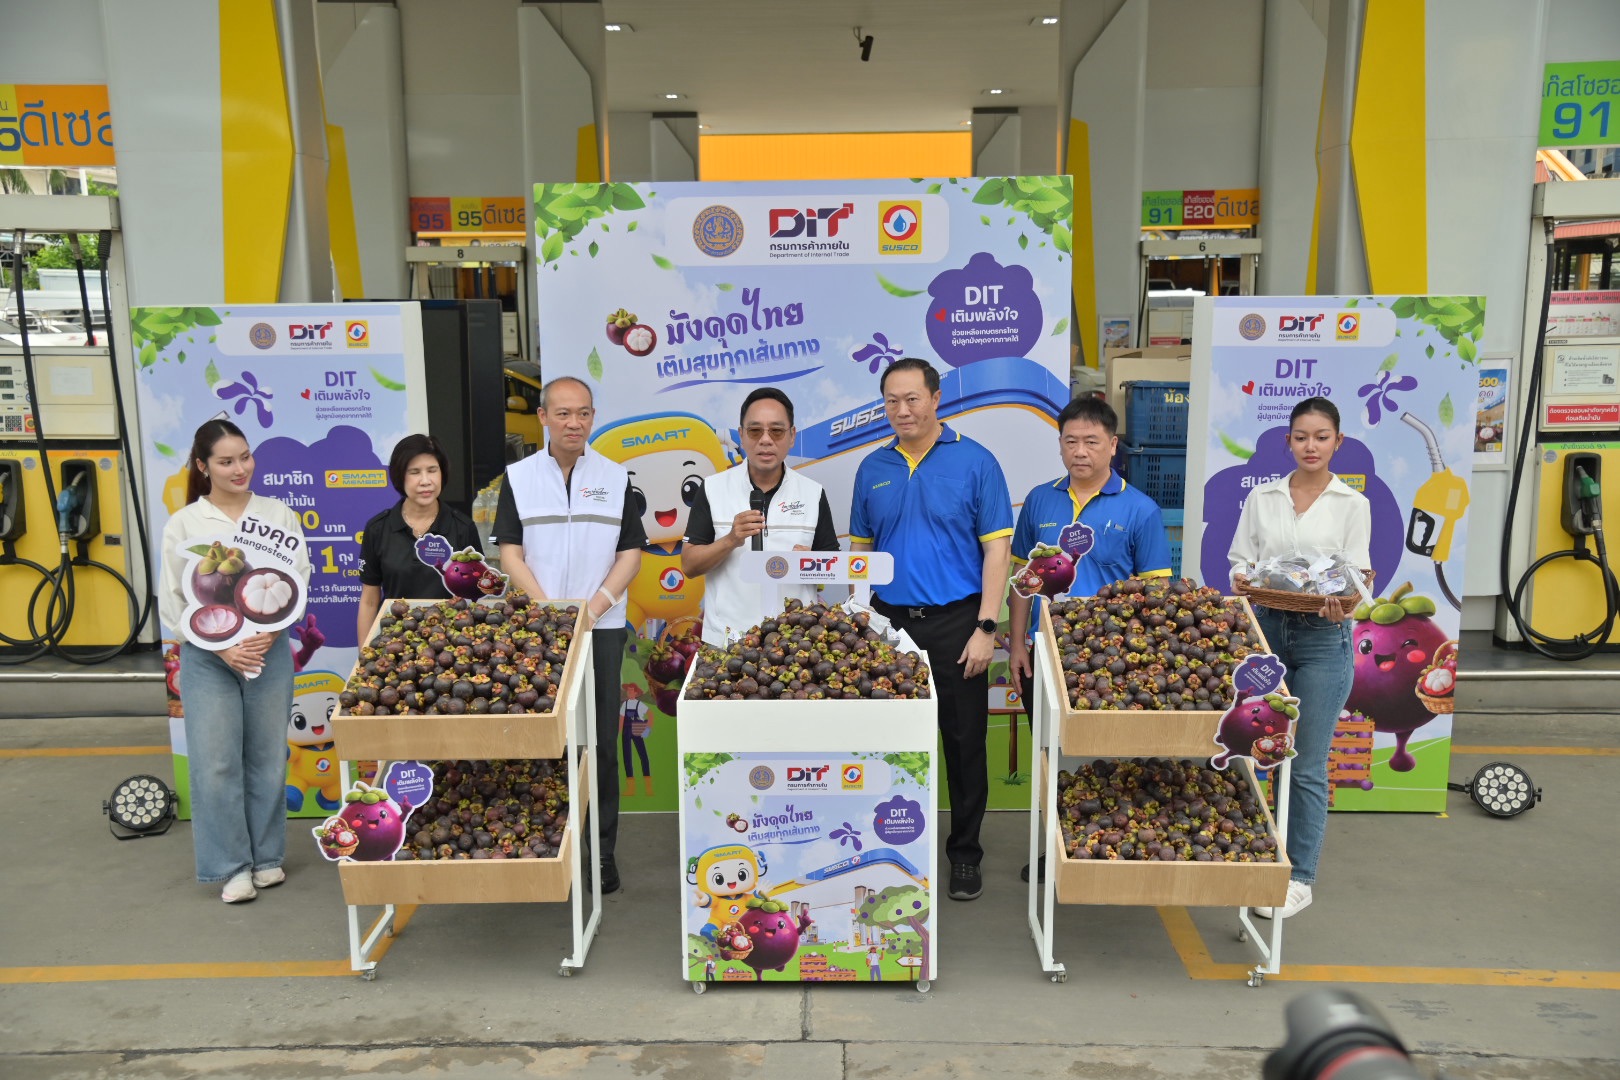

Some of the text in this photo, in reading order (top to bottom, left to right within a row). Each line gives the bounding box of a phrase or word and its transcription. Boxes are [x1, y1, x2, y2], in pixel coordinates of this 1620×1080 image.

[1552, 101, 1611, 139] 91
[0, 116, 21, 152] 5
[458, 210, 482, 227] 95
[1149, 207, 1173, 224] 91
[1184, 205, 1215, 219] E20
[418, 213, 445, 229] 95
[457, 249, 464, 258] 8
[769, 240, 850, 251] กรมการค้าภายใน
[881, 244, 919, 252] SUSCO
[1199, 242, 1206, 251] 6
[965, 285, 1004, 306] DIT
[665, 287, 804, 349] มังคุดไทย
[951, 306, 1019, 323] เติมพลังใจ
[656, 338, 821, 379] เติมสุขทุกเส้นทาง
[1275, 358, 1318, 379] DIT
[325, 371, 357, 387] DIT
[314, 389, 371, 401] เติมพลังใจ
[1258, 382, 1332, 397] เติมพลังใจ
[830, 403, 887, 437] SUSC
[621, 428, 691, 448] SMART
[263, 470, 314, 485] สมาชิก
[241, 516, 300, 551] มังคุด
[324, 523, 346, 533] บาท
[1069, 530, 1081, 538] DIT
[233, 535, 294, 566] Mangosteen
[321, 545, 339, 574] 1
[338, 553, 354, 565] ถุง
[1260, 664, 1276, 677] DIT
[400, 769, 417, 779] DIT
[752, 804, 814, 830] มังคุดไทย
[890, 808, 908, 818] DIT
[714, 850, 743, 858] SMART
